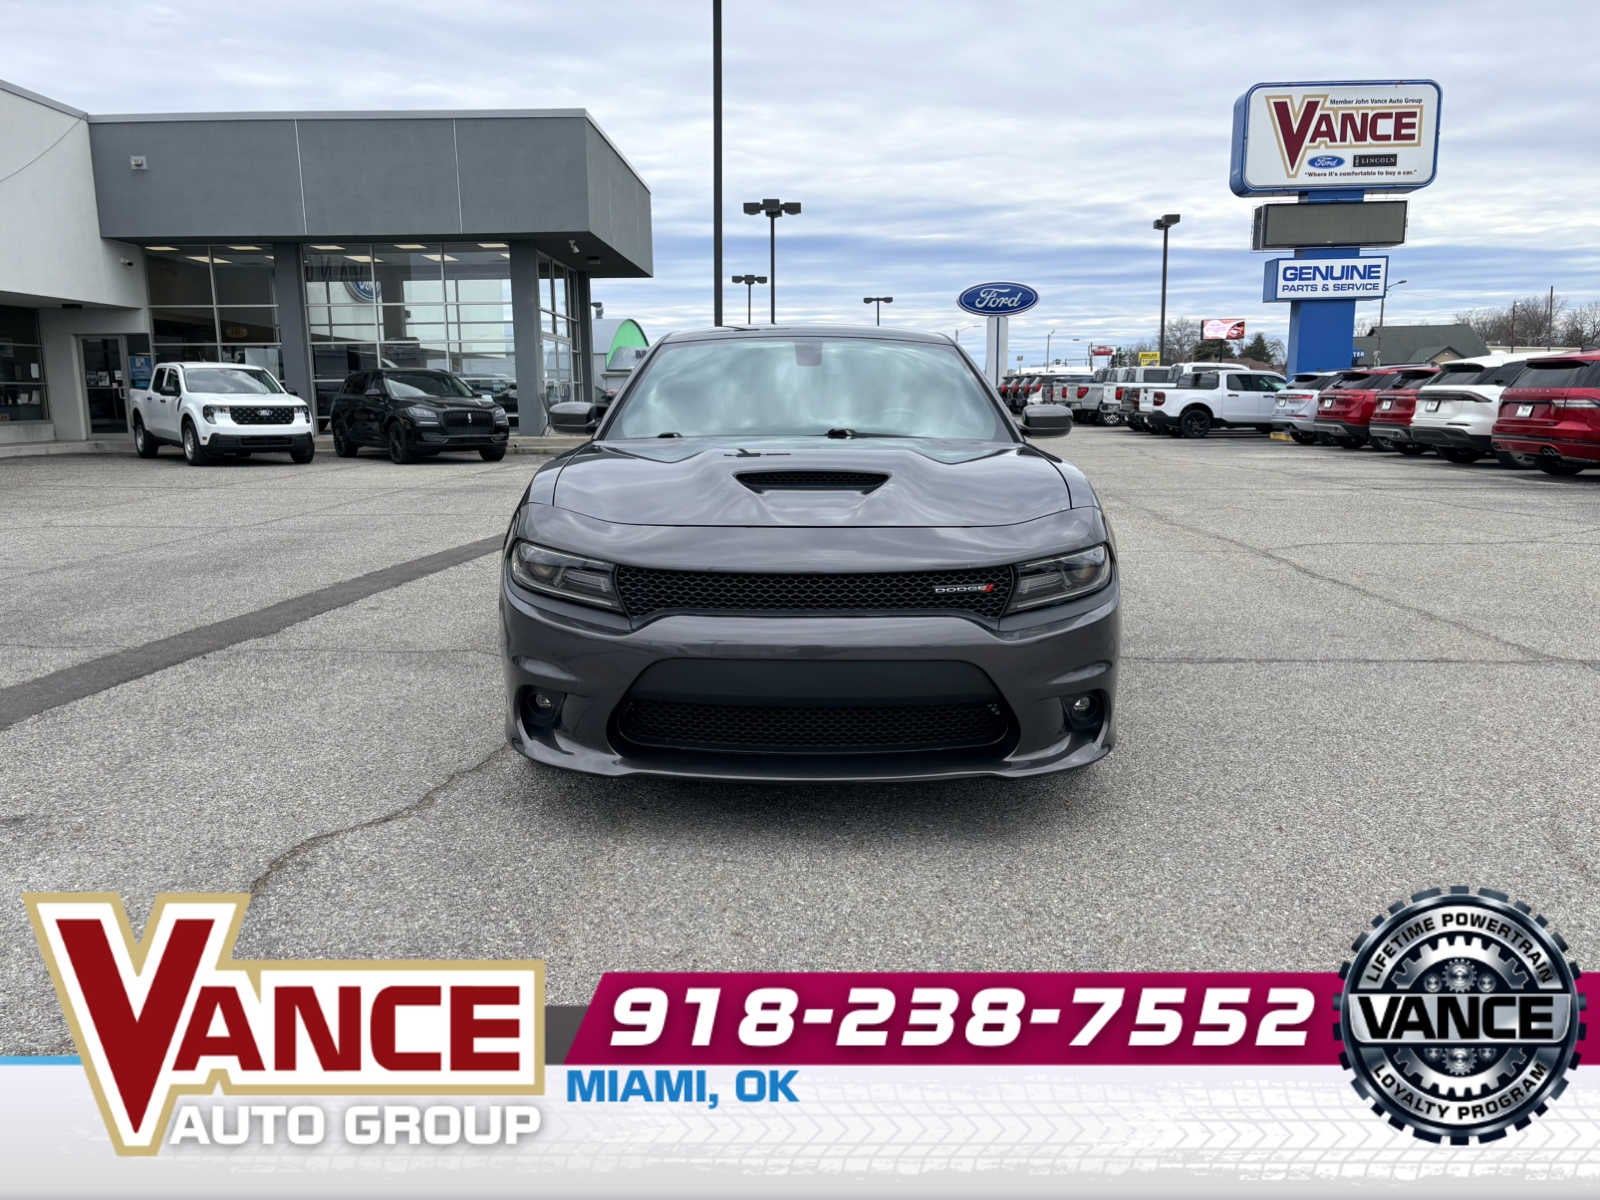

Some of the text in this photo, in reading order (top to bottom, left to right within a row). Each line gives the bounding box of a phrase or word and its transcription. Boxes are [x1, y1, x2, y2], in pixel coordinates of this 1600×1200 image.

[1404, 97, 1423, 105] Group
[1272, 100, 1418, 172] VANCE
[1314, 157, 1338, 167] Ford
[1361, 157, 1395, 165] LINCOLN
[1282, 264, 1382, 281] GENUINE
[1282, 282, 1380, 292] PARTS & SERVICE
[975, 288, 1023, 309] Ford
[935, 585, 987, 593] DODGE
